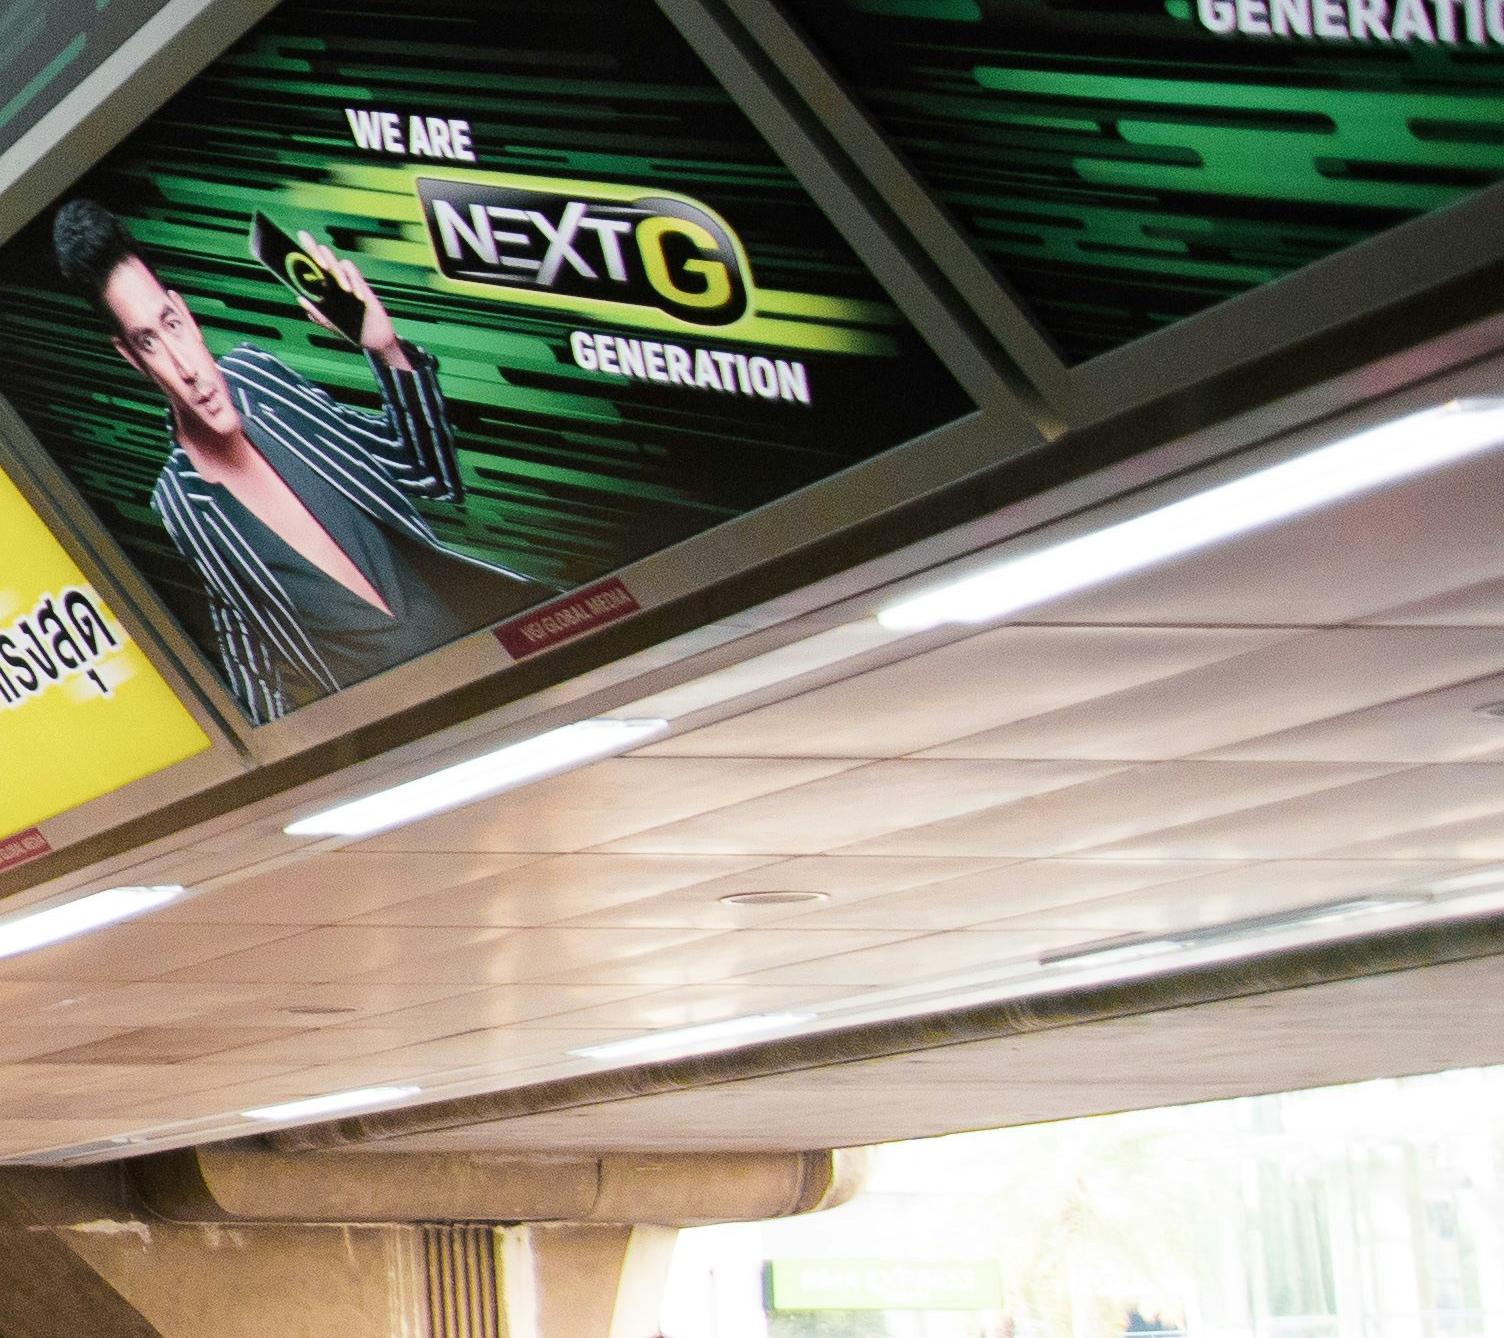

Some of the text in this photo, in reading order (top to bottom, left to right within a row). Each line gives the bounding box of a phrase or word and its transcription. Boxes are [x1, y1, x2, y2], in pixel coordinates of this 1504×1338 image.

[347, 107, 474, 163] WE ARE
[570, 330, 811, 405] GENERATION
